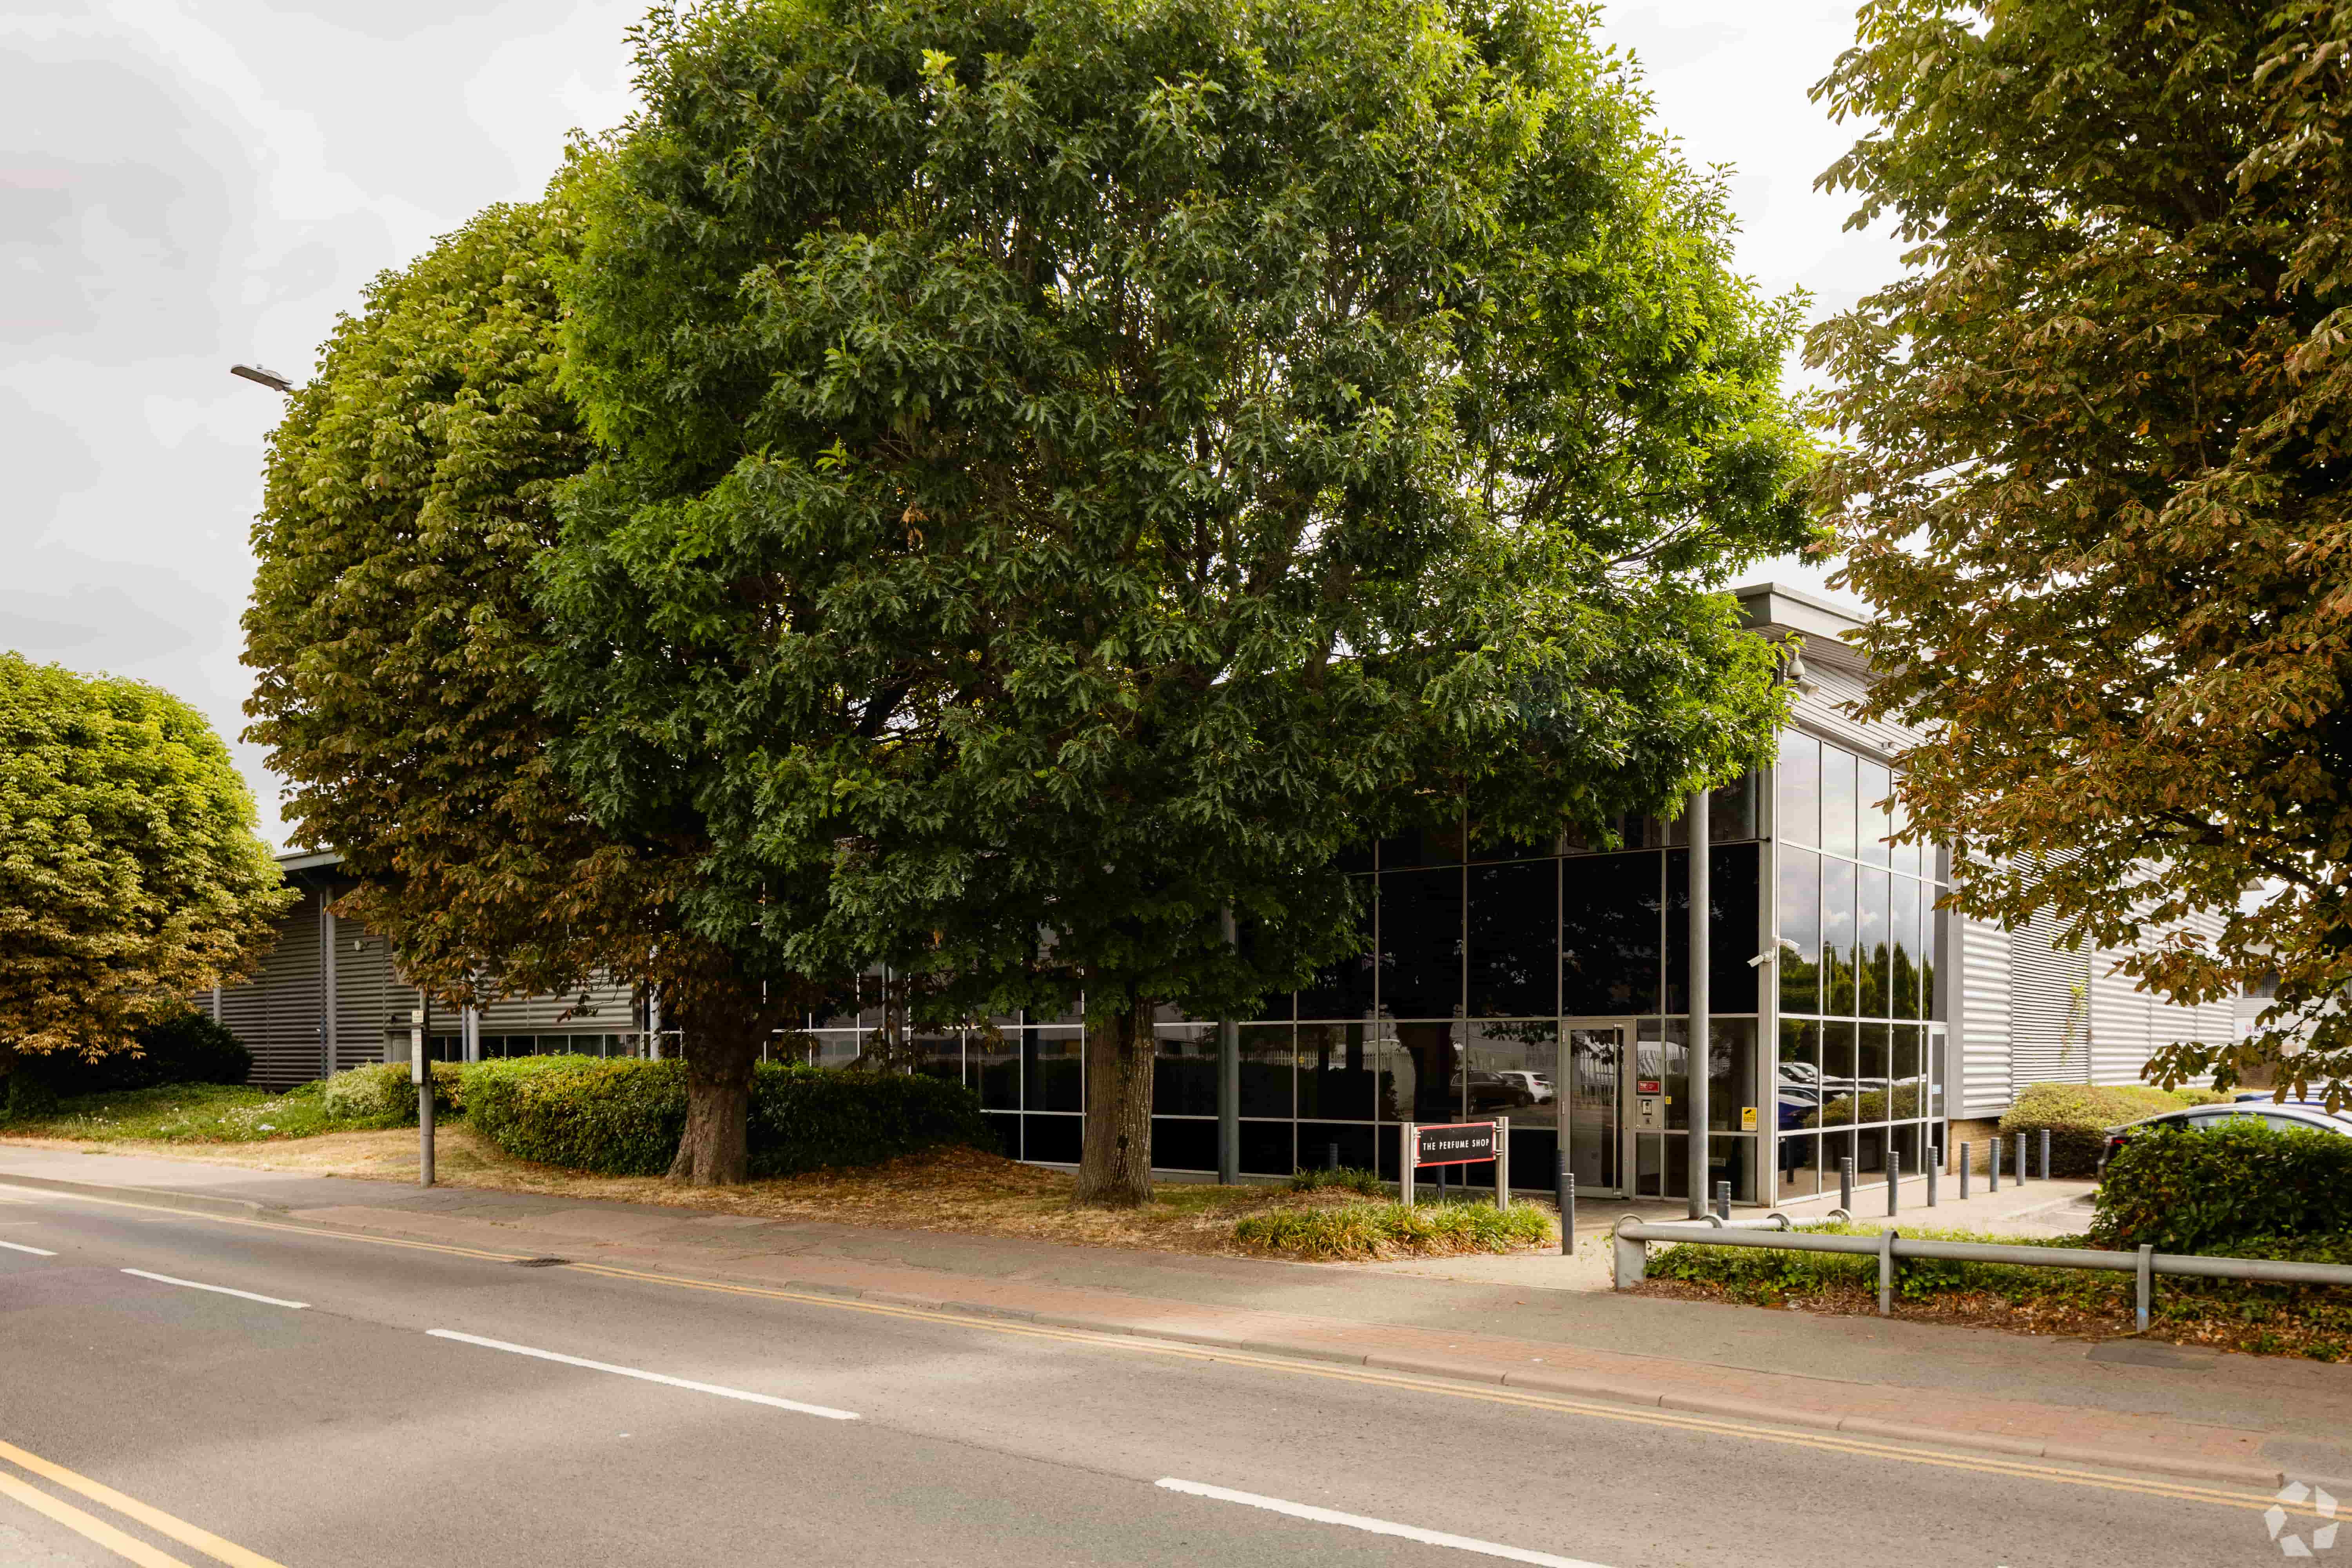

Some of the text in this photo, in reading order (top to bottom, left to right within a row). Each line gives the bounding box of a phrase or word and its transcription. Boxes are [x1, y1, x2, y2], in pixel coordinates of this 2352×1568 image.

[1423, 1138, 1489, 1151] THE PERFUME SHOP
